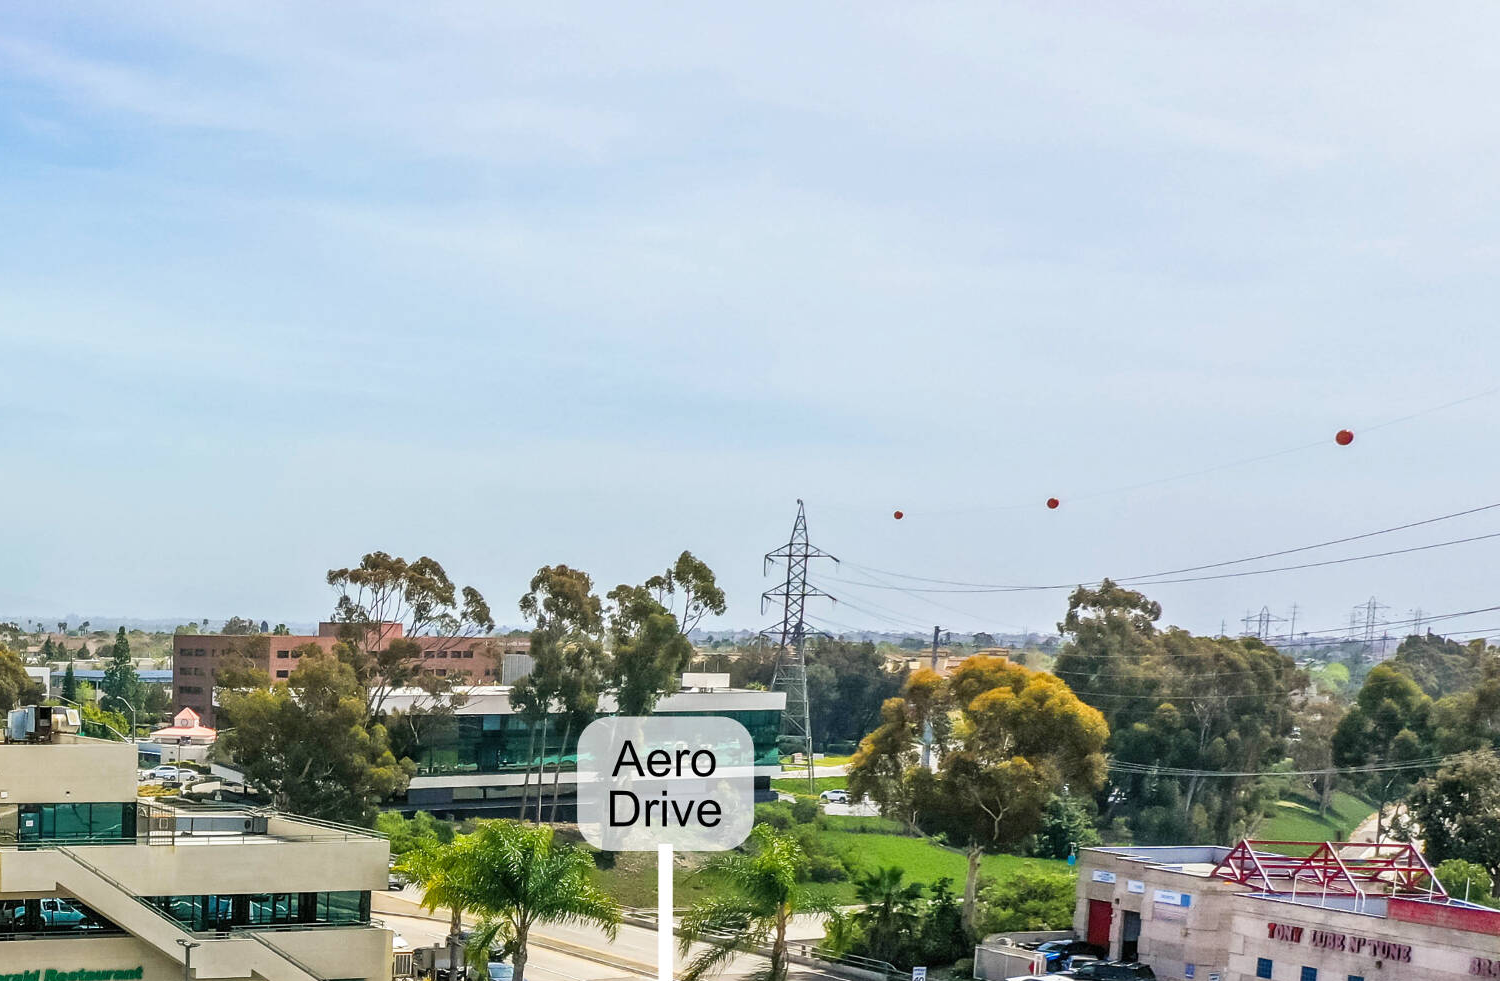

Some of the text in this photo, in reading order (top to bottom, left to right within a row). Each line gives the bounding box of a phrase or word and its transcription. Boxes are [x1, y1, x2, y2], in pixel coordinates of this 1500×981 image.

[1267, 922, 1304, 943] TONY
[1311, 929, 1346, 952] LUBE
[1367, 939, 1412, 963] TUNE
